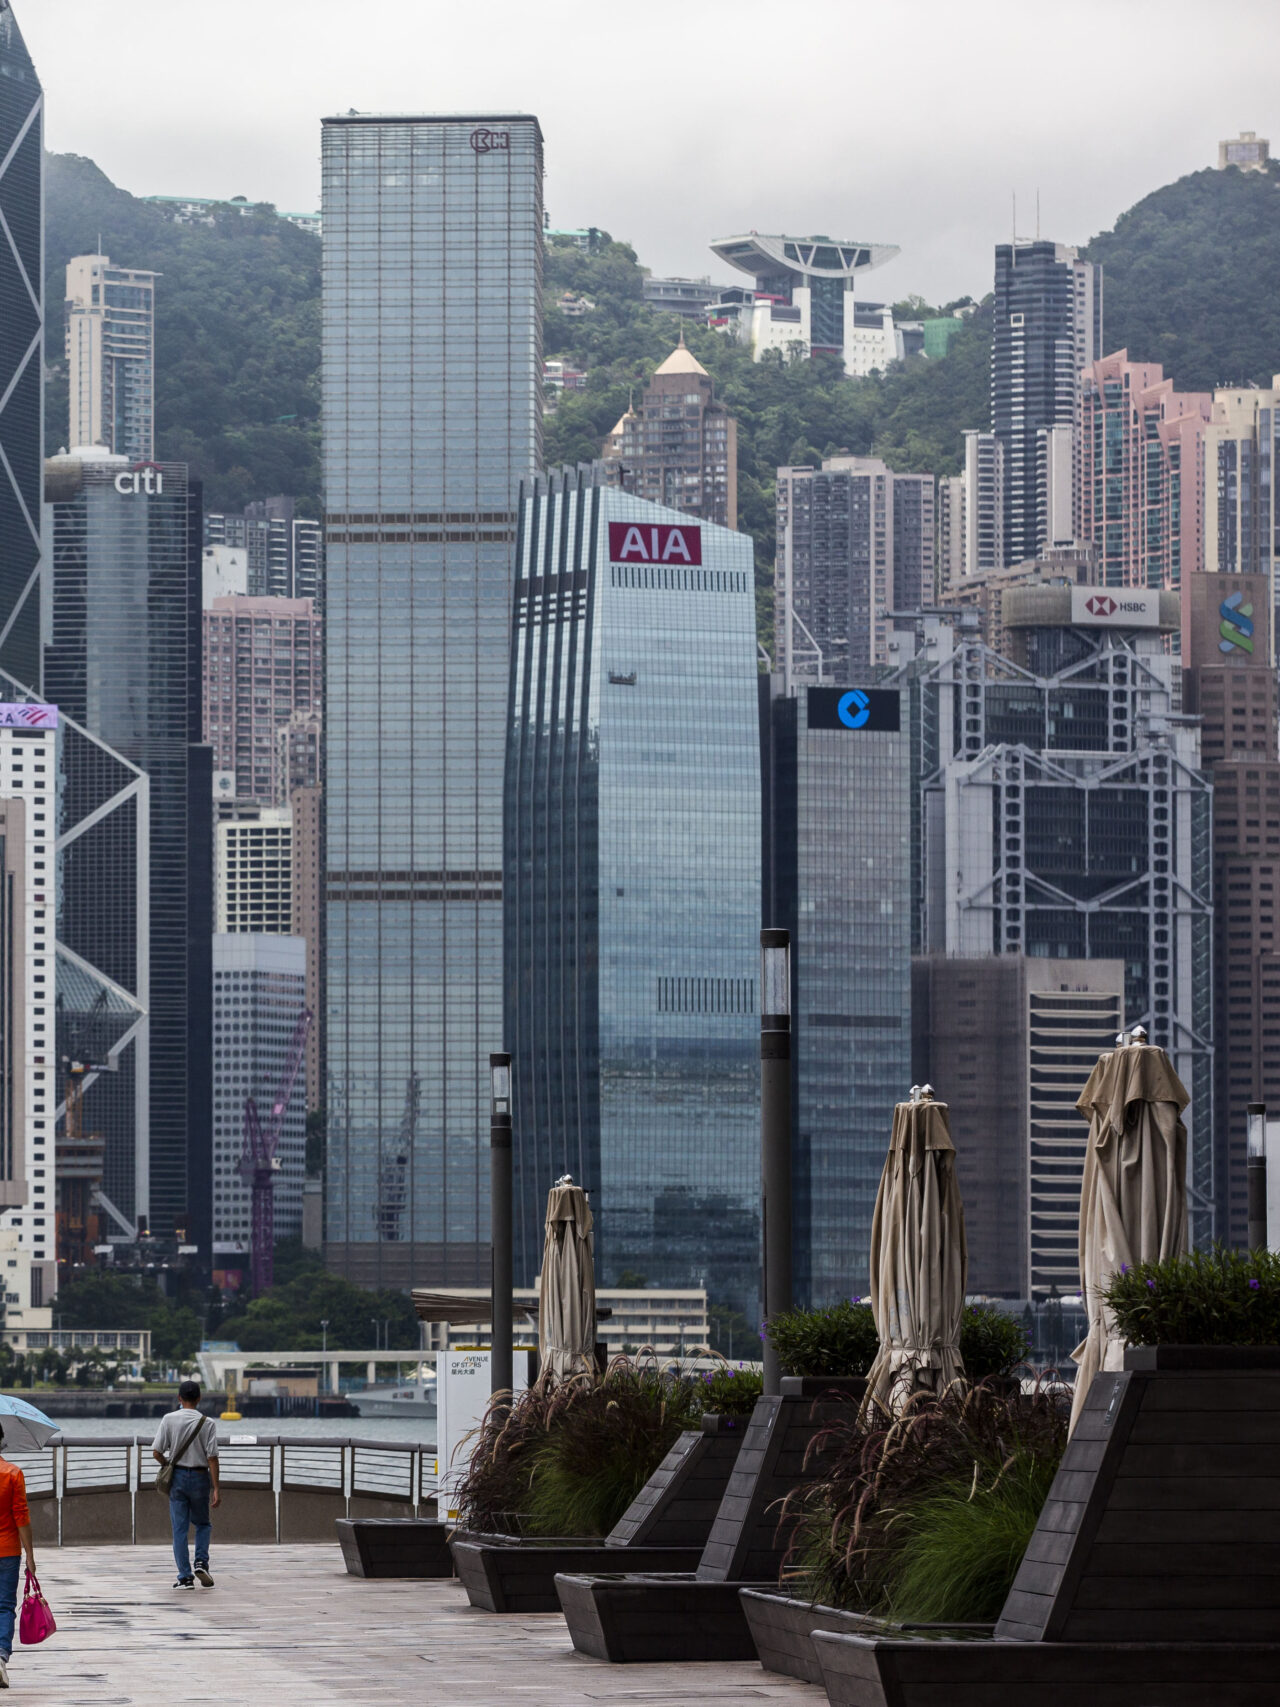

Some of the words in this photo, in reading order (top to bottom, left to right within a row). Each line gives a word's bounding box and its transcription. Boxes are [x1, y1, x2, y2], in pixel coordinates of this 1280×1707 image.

[114, 466, 163, 494] citi
[620, 526, 691, 562] AIA
[1119, 602, 1146, 612] HSBC
